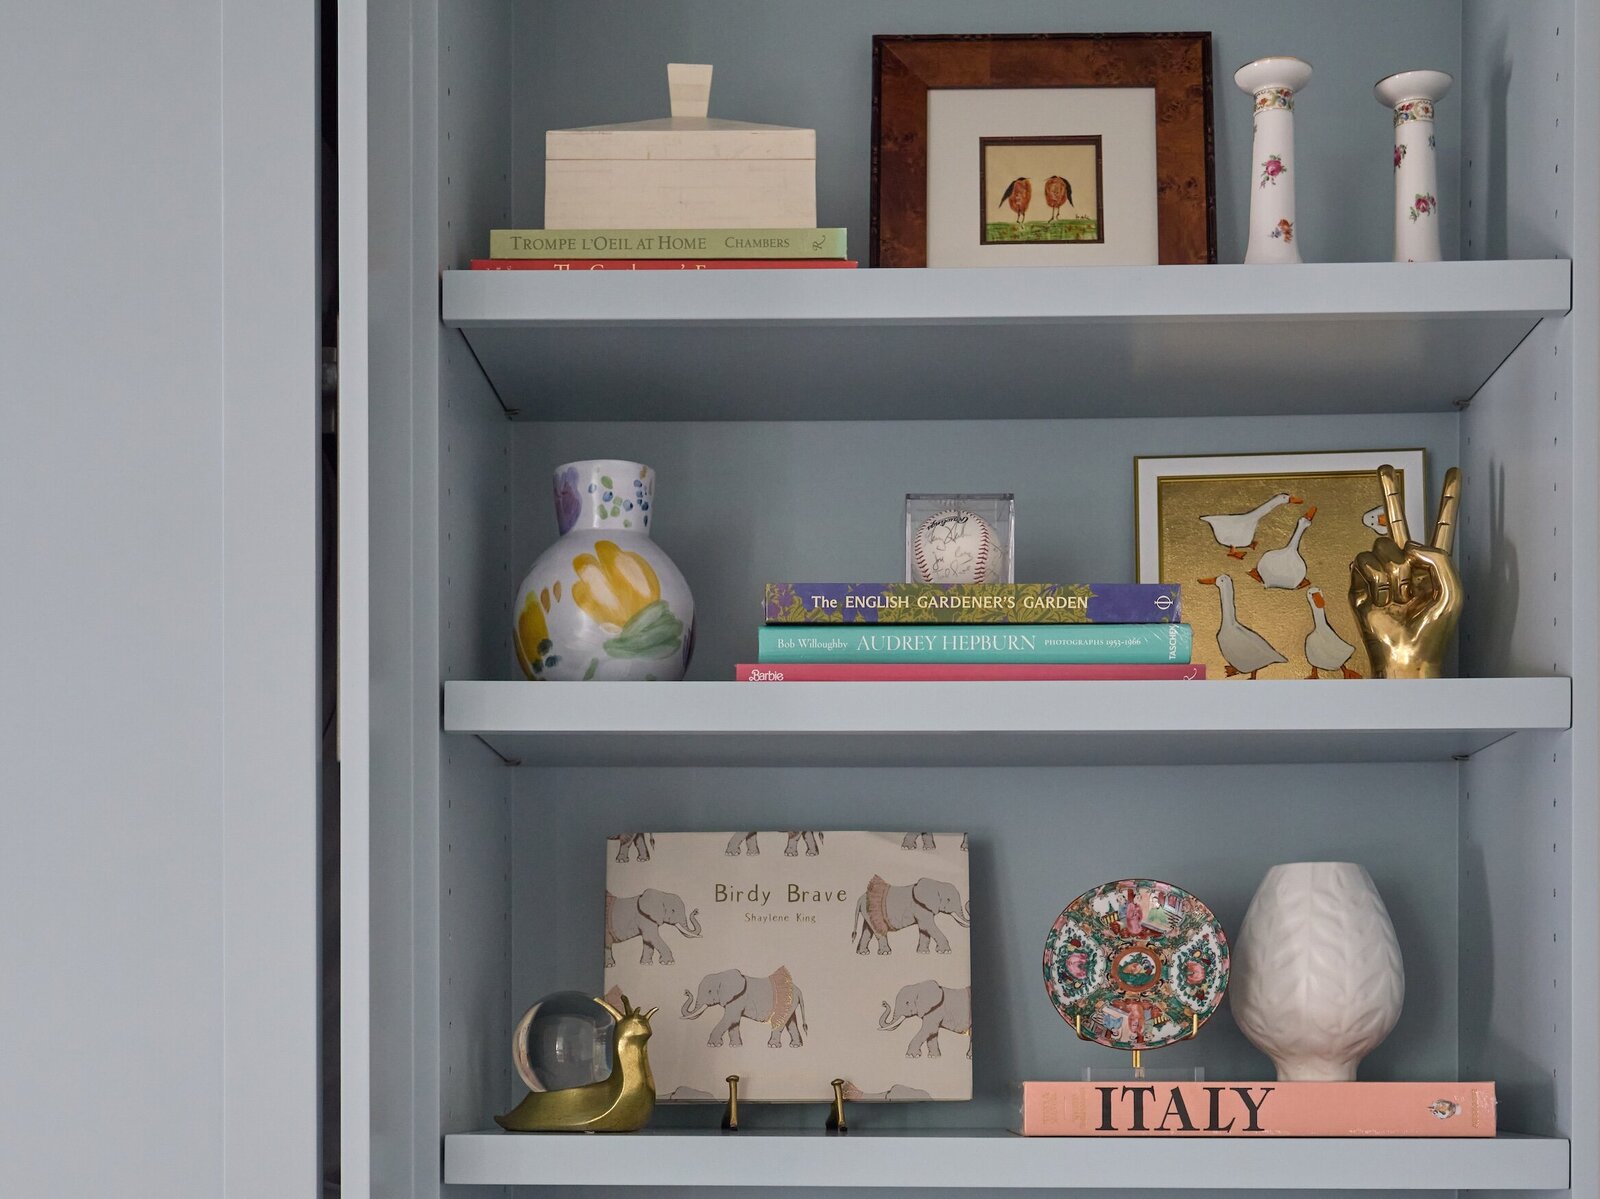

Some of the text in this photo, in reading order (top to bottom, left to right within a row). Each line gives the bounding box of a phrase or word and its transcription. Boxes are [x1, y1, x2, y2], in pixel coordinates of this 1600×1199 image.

[637, 237, 655, 251] AT
[658, 235, 707, 251] HOME
[724, 236, 791, 249] CHAMBERS
[811, 595, 1088, 609] The ENGLISH GARDENER'S GARDEN
[777, 638, 848, 651] Bob Willoughby
[856, 635, 1036, 651] AUDREY HEPBURN
[1168, 625, 1177, 661] TASCHEN
[749, 669, 784, 681] Barbie
[715, 883, 847, 906] Birdy Brave
[744, 912, 817, 923] Shaylene King
[1095, 1085, 1275, 1133] ITALY
